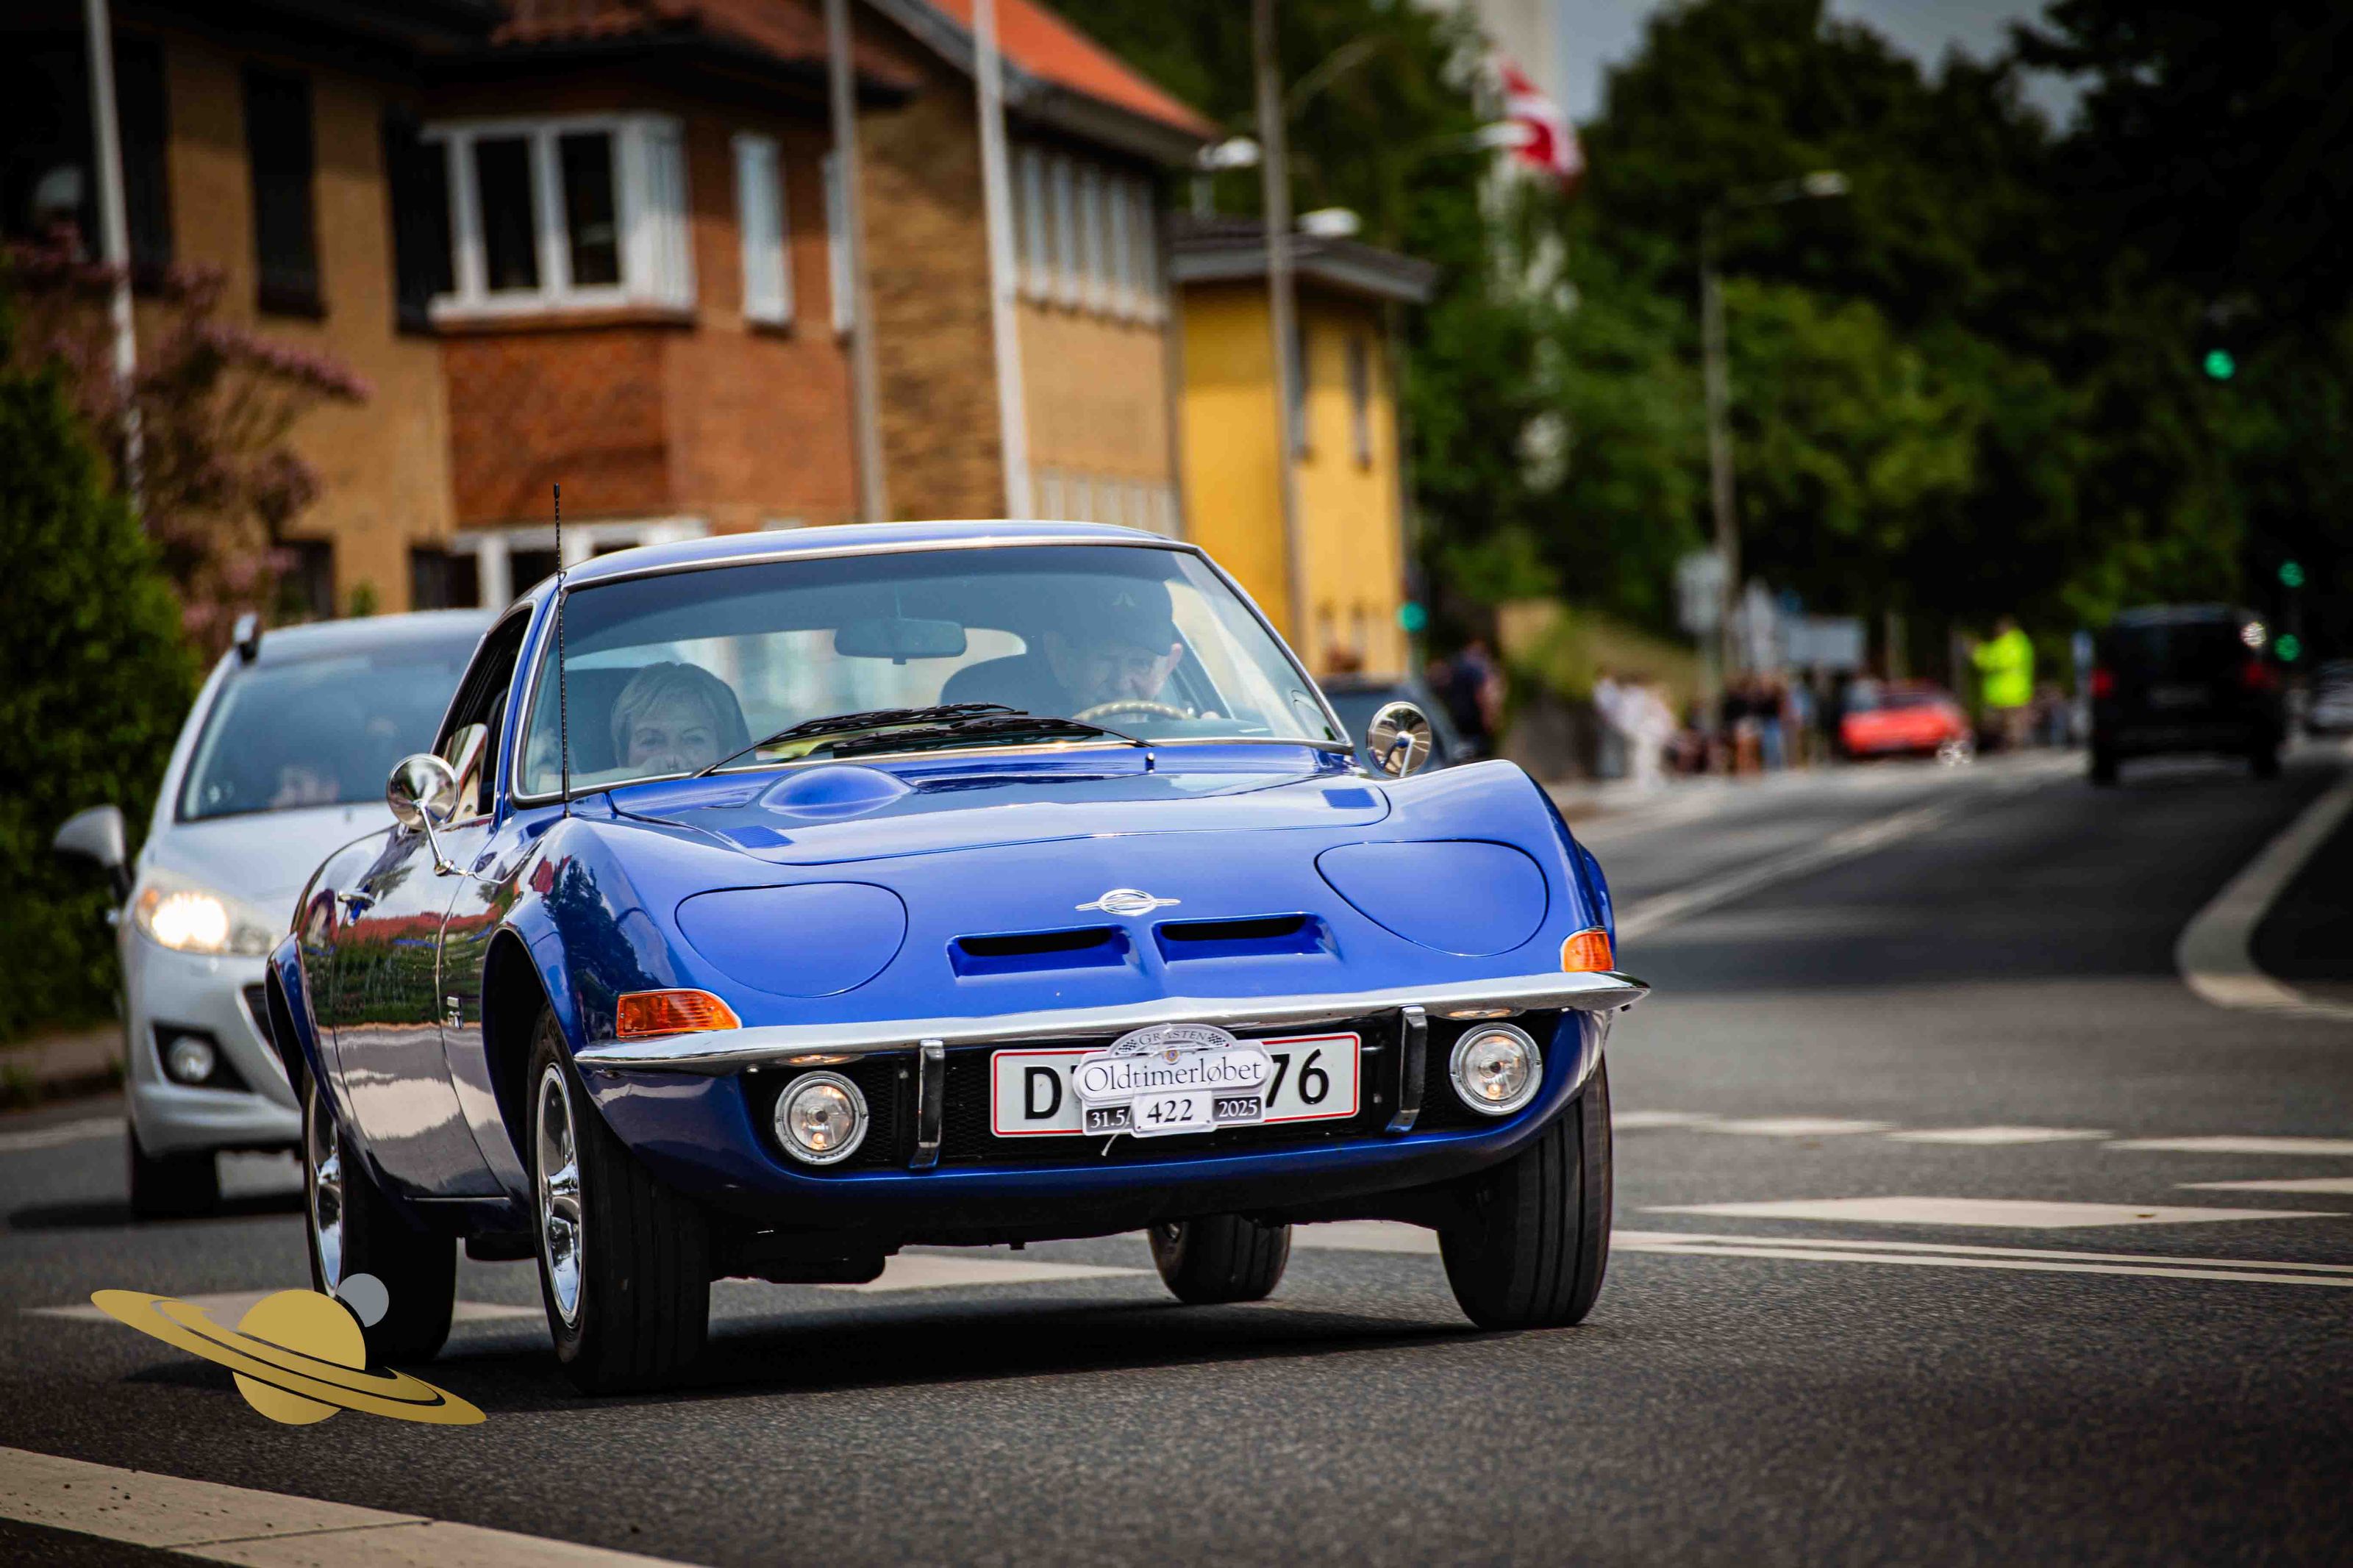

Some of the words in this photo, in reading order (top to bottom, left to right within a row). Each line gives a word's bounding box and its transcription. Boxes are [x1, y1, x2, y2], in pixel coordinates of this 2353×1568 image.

[1085, 1057, 1262, 1092] Oldtimerløbet
[1146, 1099, 1193, 1124] 422
[1218, 1099, 1258, 1118] 2025
